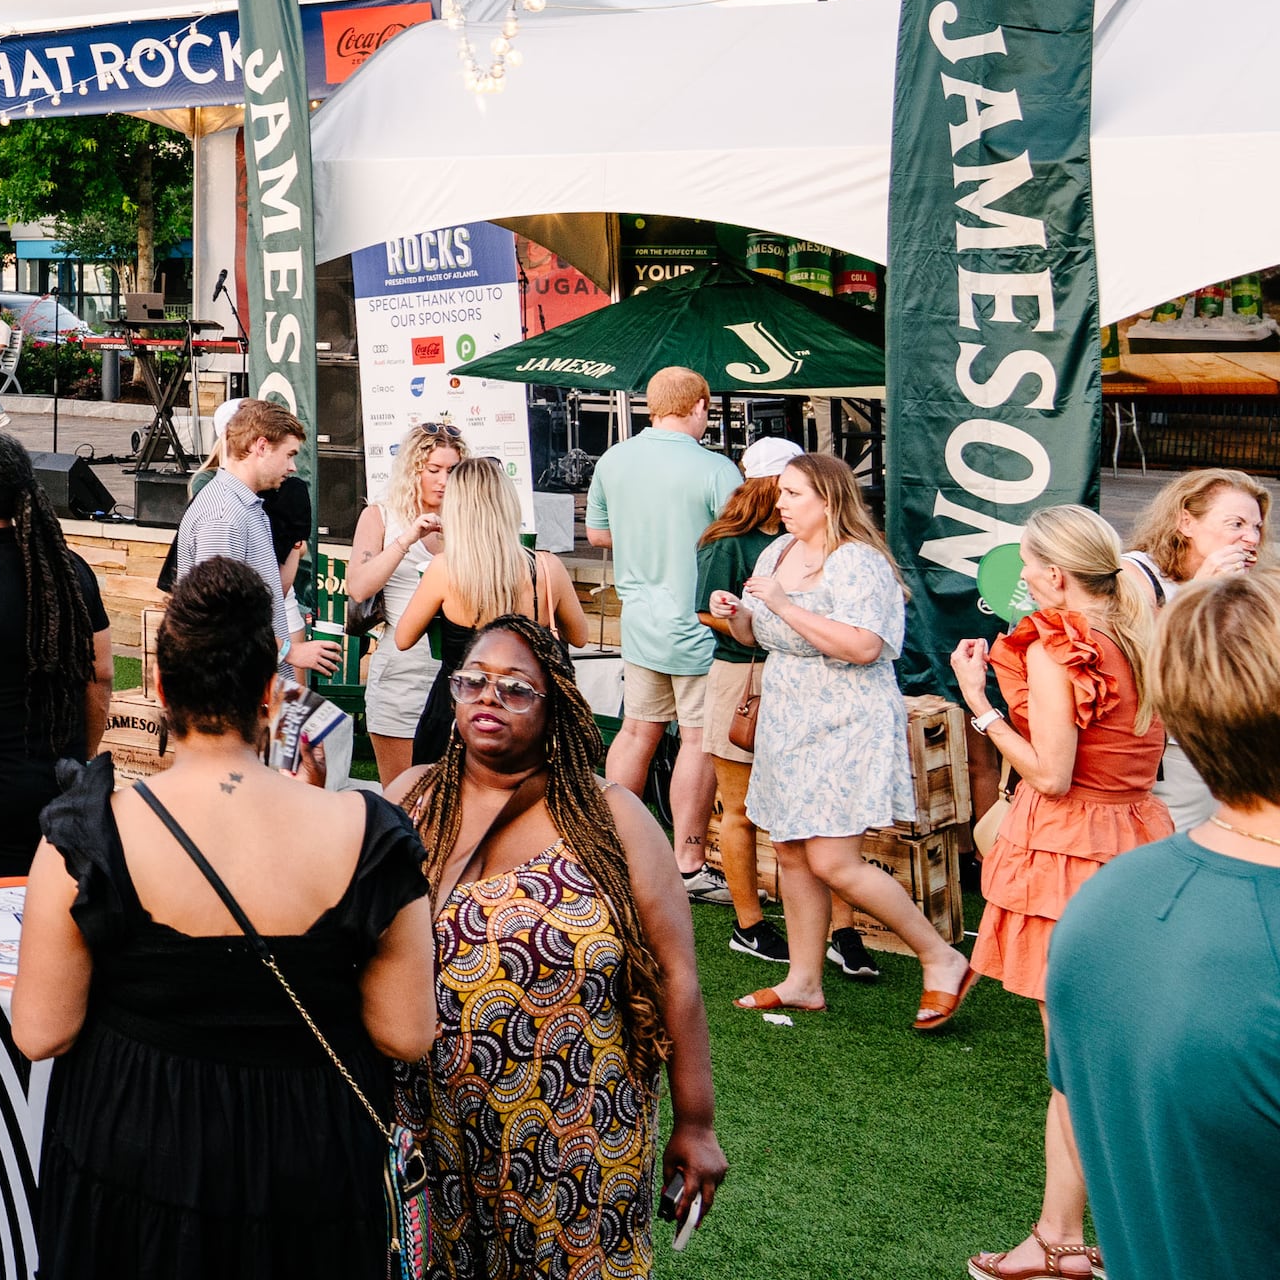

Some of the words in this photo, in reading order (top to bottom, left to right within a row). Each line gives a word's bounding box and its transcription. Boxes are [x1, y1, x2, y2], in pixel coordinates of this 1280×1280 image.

[88, 28, 244, 93] ROCK
[244, 48, 303, 420] JAMESO
[384, 226, 473, 276] ROCKS
[635, 248, 649, 256] FOR
[650, 248, 662, 256] THE
[663, 248, 695, 256] PERFECT
[695, 248, 708, 256] MIX
[746, 242, 786, 258] JAMESON
[786, 241, 834, 258] JAMESON
[418, 275, 426, 284] BY
[426, 274, 443, 283] TASTE
[443, 272, 453, 281] OF
[453, 270, 479, 280] ATLANTA
[850, 273, 867, 282] COLA
[368, 295, 415, 313] SPECIAL
[414, 292, 456, 308] THANK
[458, 289, 484, 304] YOU
[484, 286, 503, 301] TO
[917, 0, 1060, 580] JAMESON
[390, 313, 416, 328] OUR
[419, 307, 483, 326] SPONSORS
[515, 356, 617, 380] JAMESON
